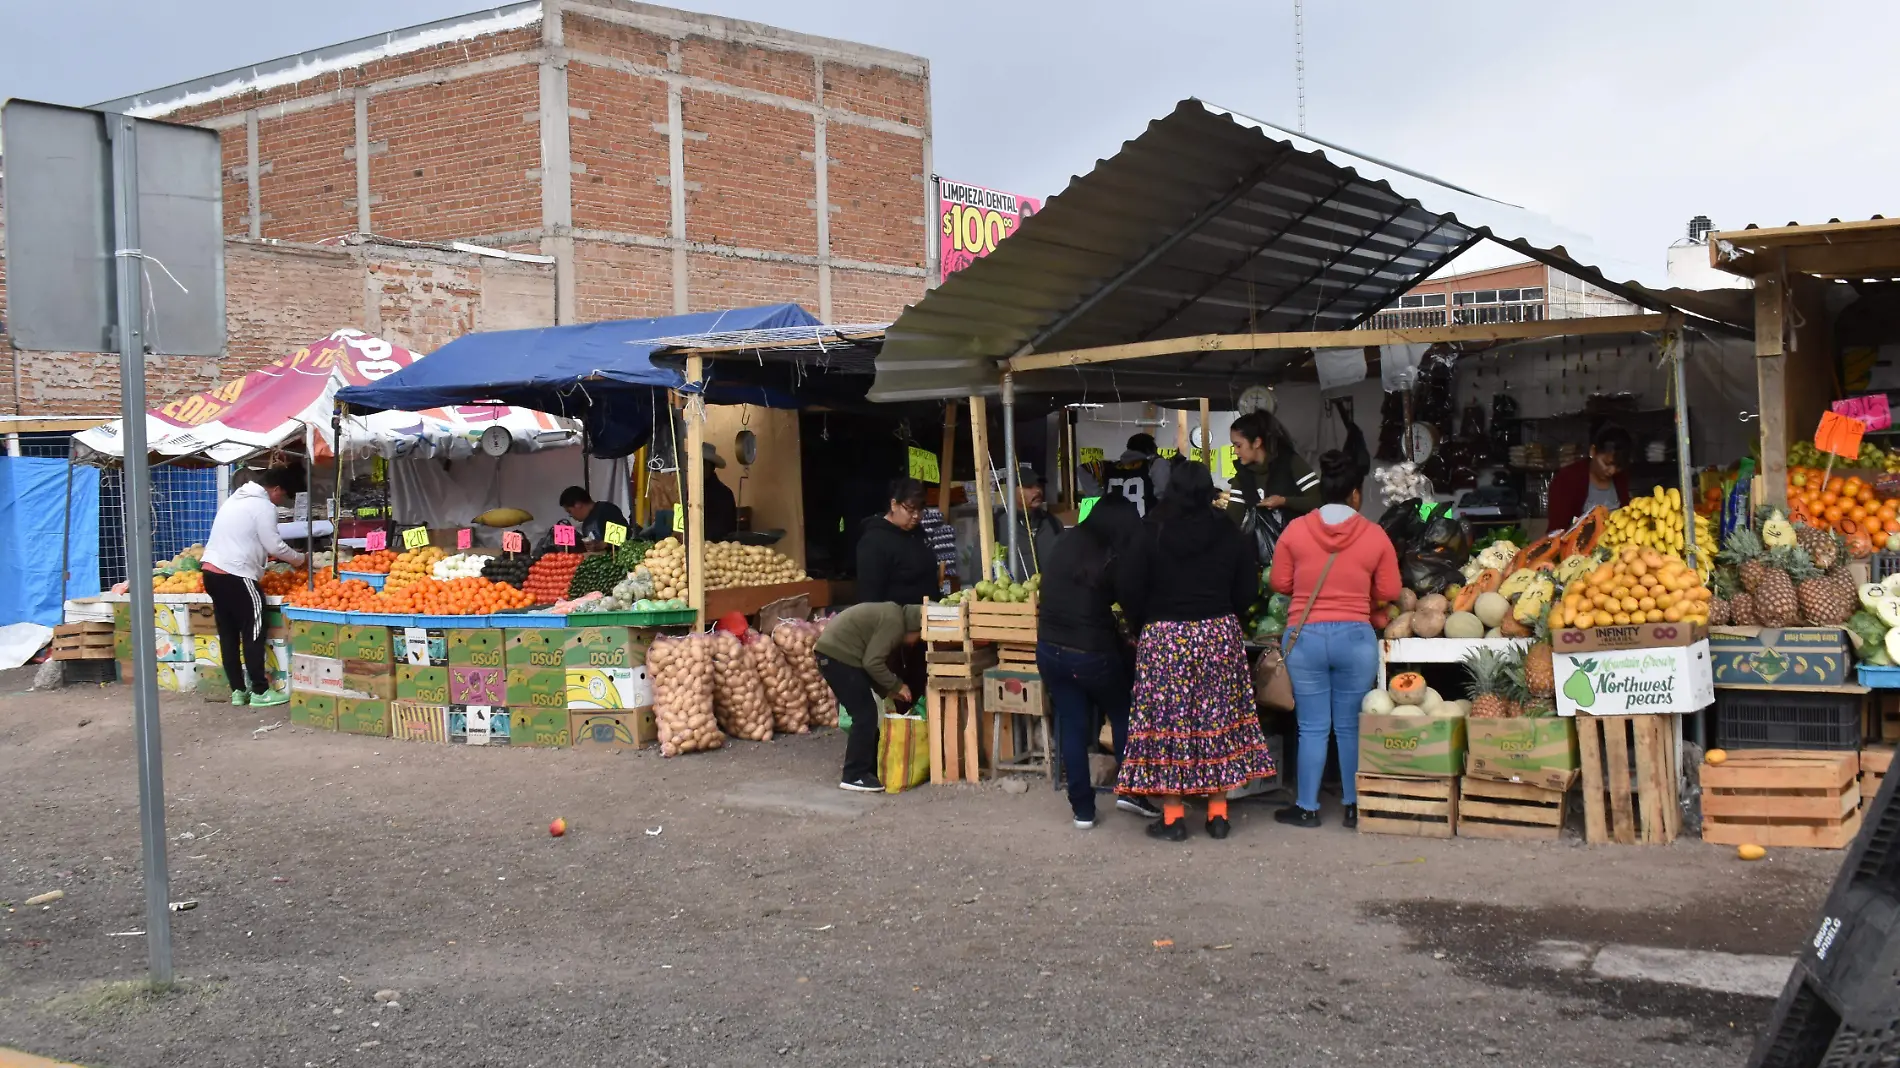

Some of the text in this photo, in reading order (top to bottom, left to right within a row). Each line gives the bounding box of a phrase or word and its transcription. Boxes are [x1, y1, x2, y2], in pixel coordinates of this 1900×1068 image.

[942, 181, 1018, 214] LIMPIEZA DENTAL
[1595, 627, 1640, 638] INFINITY
[1595, 671, 1675, 694] Northwest
[1625, 692, 1673, 710] pears
[1813, 916, 1832, 947] GRUPO
[1816, 917, 1842, 960] MODELO
